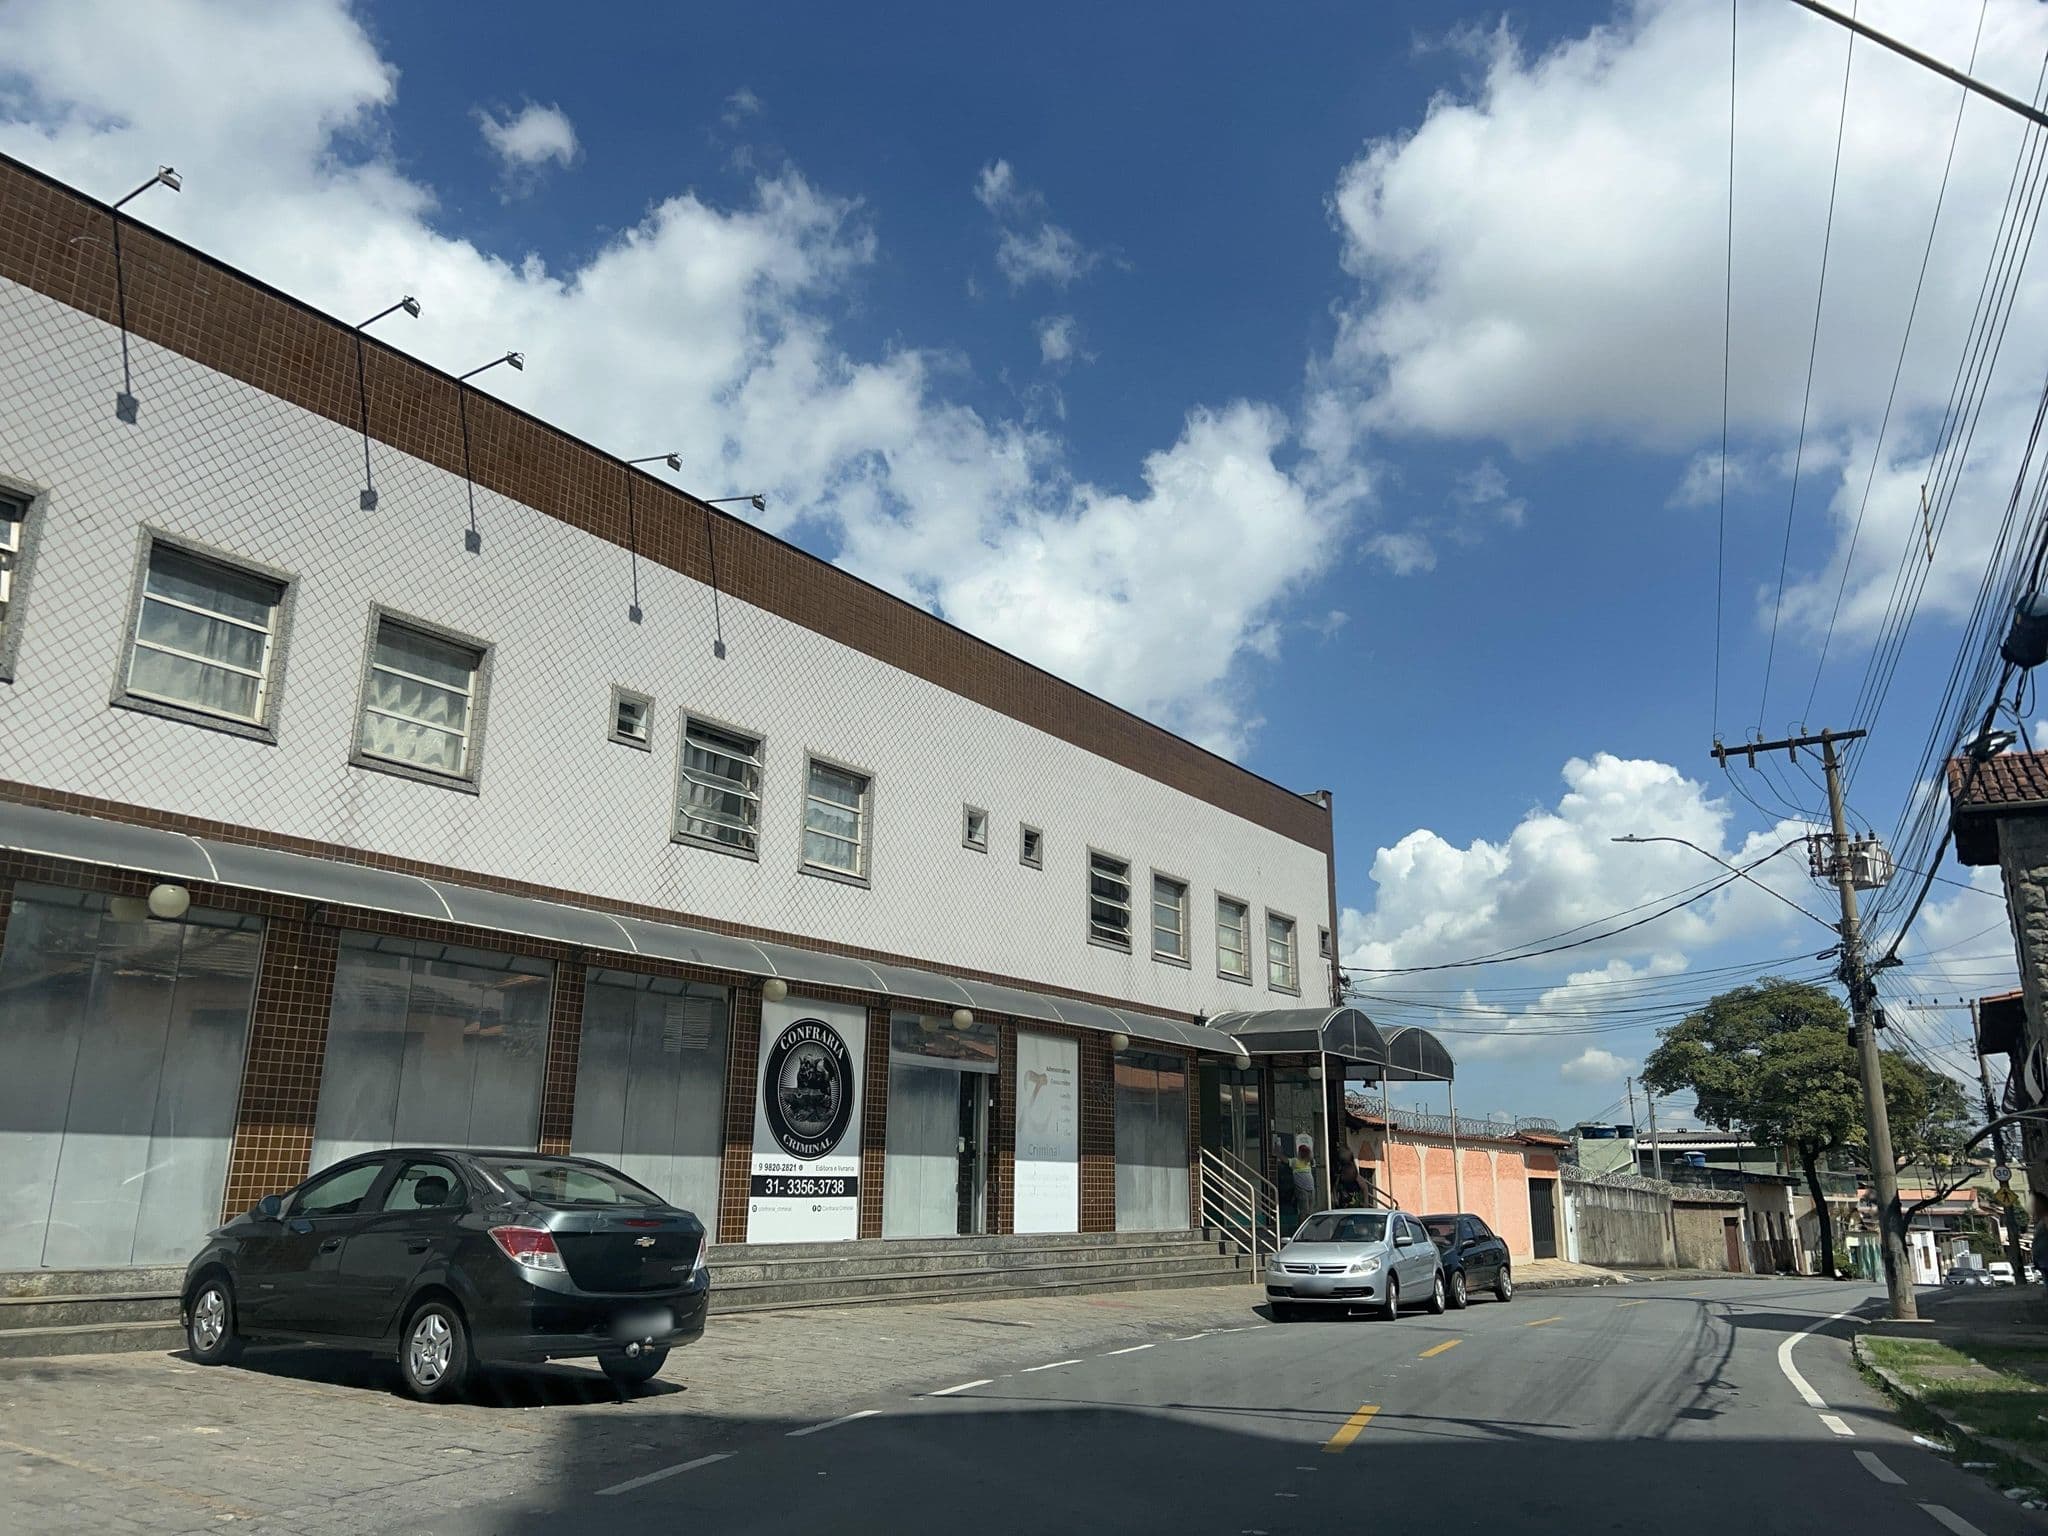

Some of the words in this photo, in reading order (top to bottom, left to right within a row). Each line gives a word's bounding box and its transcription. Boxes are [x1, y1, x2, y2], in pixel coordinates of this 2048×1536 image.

[780, 1025, 844, 1060] CONFRARIA
[783, 1133, 833, 1154] CRIMINAL
[758, 1163, 763, 1171] 9
[765, 1178, 785, 1194] 31-
[787, 1178, 845, 1195] 3356-3738
